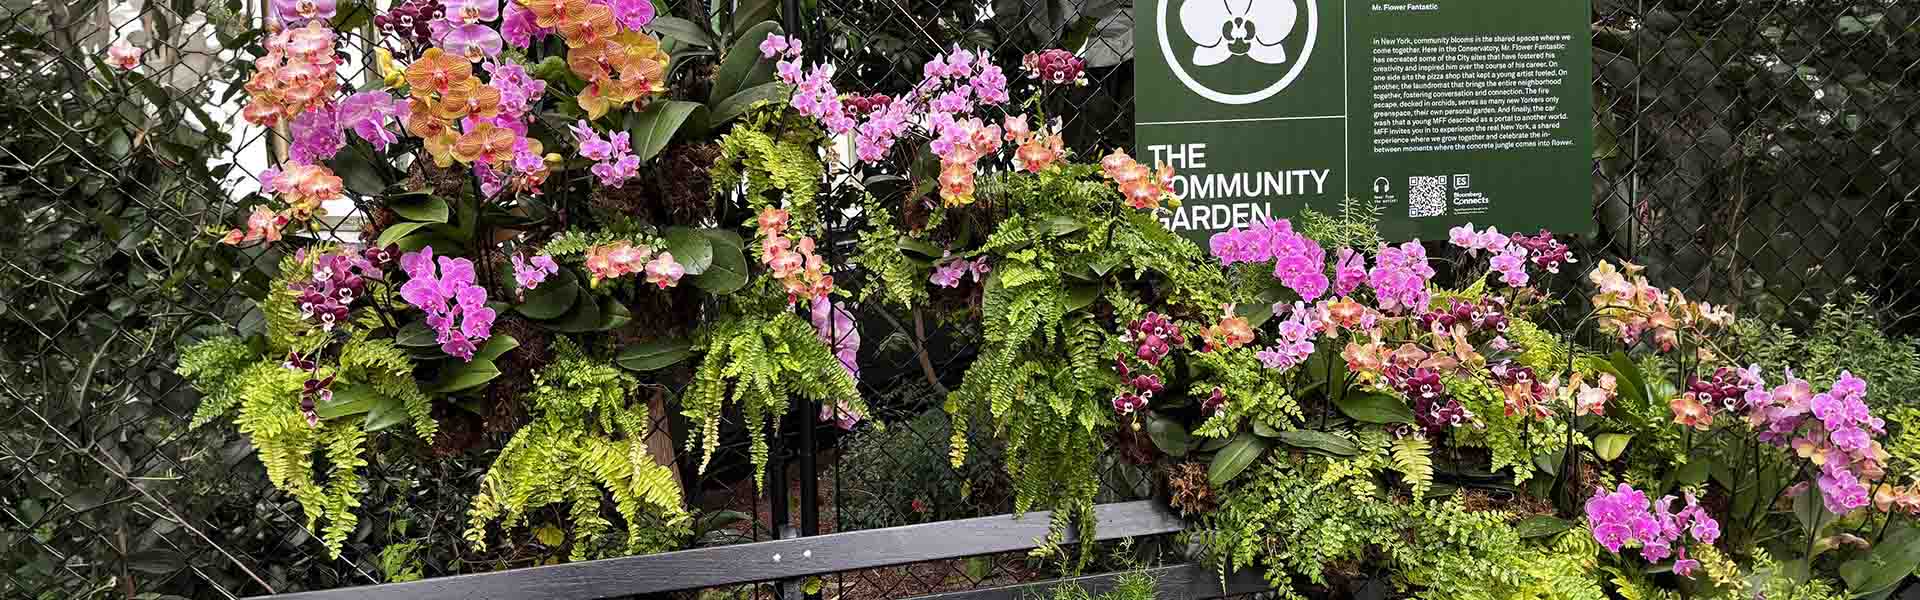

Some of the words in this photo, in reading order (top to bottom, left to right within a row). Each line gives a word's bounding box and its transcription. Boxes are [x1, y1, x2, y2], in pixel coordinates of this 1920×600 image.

[1413, 36, 1449, 45] community
[1450, 35, 1474, 43] blooms
[1516, 35, 1539, 43] spaces
[1458, 44, 1500, 54] Conservatory,
[1512, 43, 1533, 51] Flower
[1535, 42, 1566, 50] Fantastic
[1386, 54, 1418, 62] recreated
[1457, 53, 1469, 62] City
[1373, 64, 1404, 74] creativity
[1418, 63, 1445, 72] inspired
[1427, 72, 1444, 80] pizza
[1445, 71, 1461, 80] shop
[1477, 70, 1490, 79] kept
[1497, 71, 1515, 79] young
[1373, 82, 1400, 91] another,
[1451, 80, 1464, 88] that
[1466, 80, 1485, 89] brings
[1486, 79, 1497, 87] the
[1518, 78, 1561, 87] neighborhood
[1373, 91, 1402, 100] together,
[1403, 90, 1432, 99] fostering
[1433, 89, 1474, 97] conversation
[1475, 88, 1487, 96] and
[1488, 87, 1525, 95] connection.
[1431, 99, 1457, 107] orchids,
[1545, 96, 1559, 104] only
[1373, 110, 1413, 118] greenspace,
[1445, 107, 1472, 116] personal
[1412, 118, 1431, 126] young
[1432, 116, 1447, 124] MFF
[1448, 115, 1479, 123] described
[1494, 114, 1514, 123] portal
[1522, 113, 1547, 121] another
[1390, 126, 1411, 134] invites
[1412, 127, 1424, 135] you
[1440, 124, 1475, 134] experience
[1487, 123, 1499, 131] real
[1515, 122, 1531, 130] York,
[1373, 135, 1409, 145] experience
[1410, 134, 1430, 142] where
[1458, 132, 1485, 142] together
[1498, 131, 1529, 139] celebrate
[1374, 144, 1401, 152] between
[1403, 143, 1433, 151] moments
[1434, 142, 1454, 150] where
[1466, 141, 1494, 149] concrete
[1495, 140, 1514, 149] jungle
[1551, 138, 1574, 146] flower.
[1148, 143, 1206, 170] THE
[1171, 169, 1330, 200] OMMUNITY
[1457, 177, 1467, 186] ES
[1454, 197, 1489, 205] Connects
